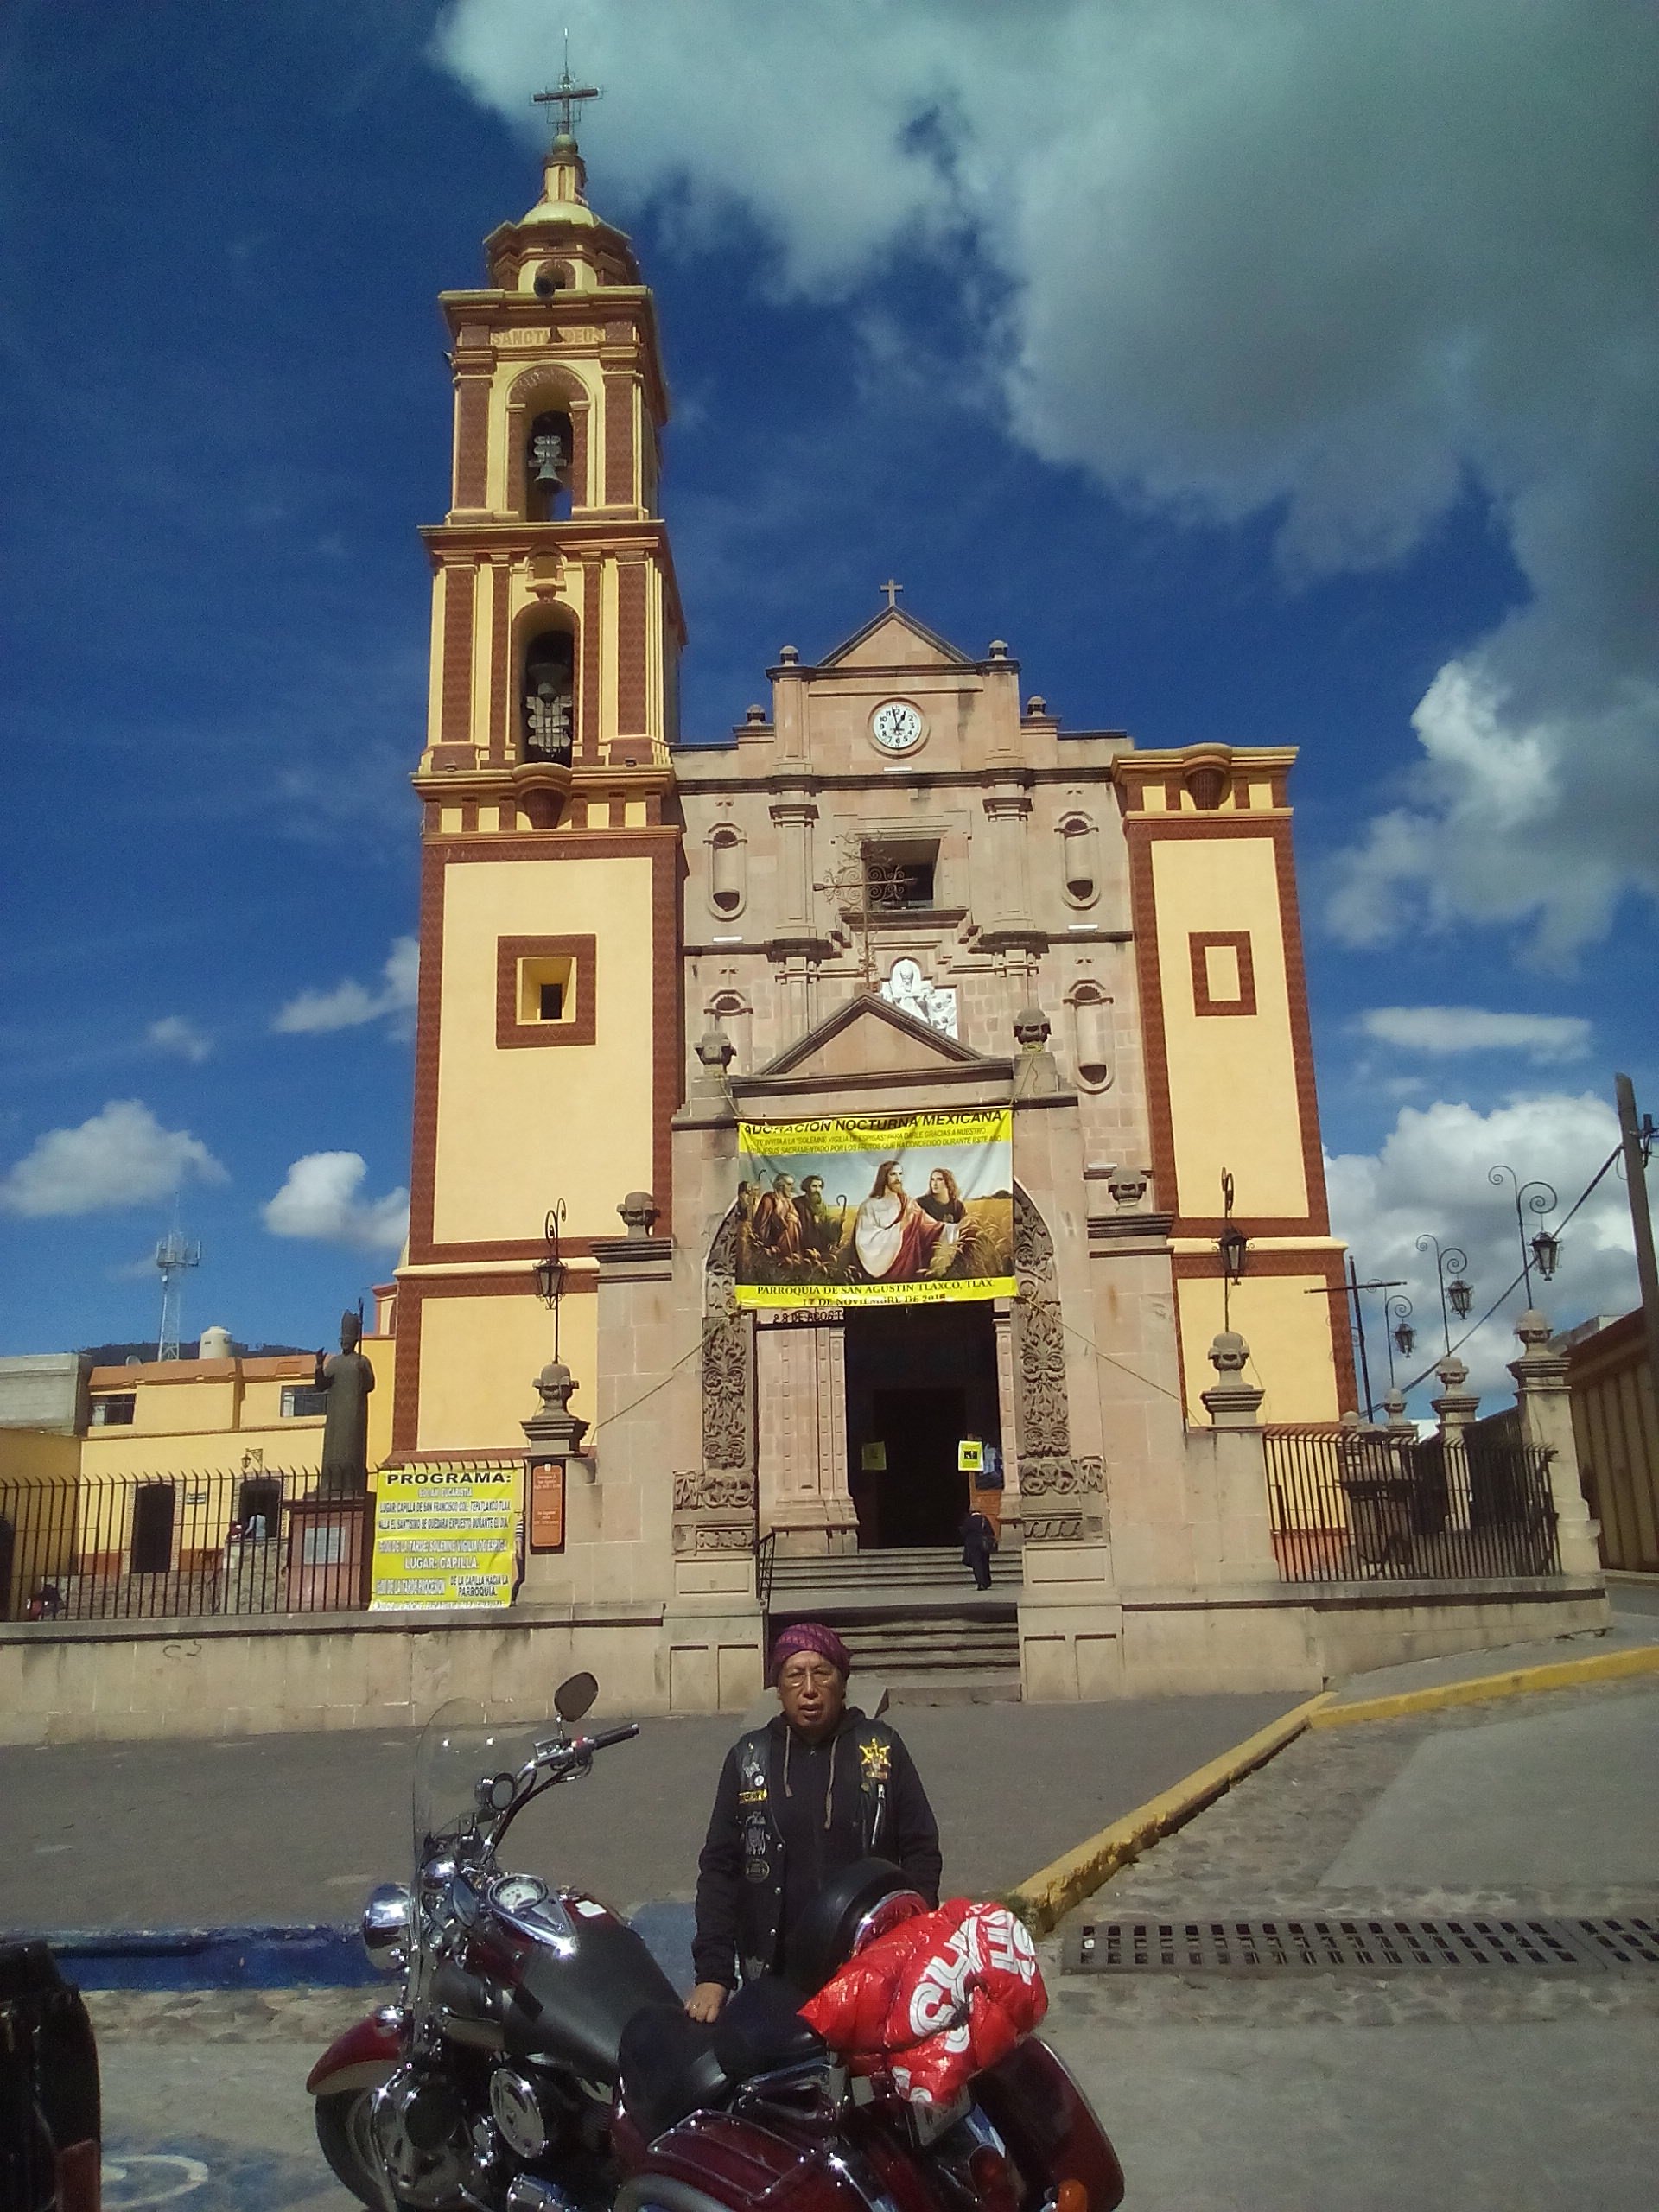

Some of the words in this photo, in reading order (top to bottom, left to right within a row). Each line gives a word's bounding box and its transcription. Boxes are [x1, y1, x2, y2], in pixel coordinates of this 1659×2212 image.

[492, 330, 555, 345] SANCT
[836, 1116, 918, 1130] NOCTURNA
[923, 1110, 1001, 1125] MEXICANA
[924, 1128, 951, 1137] GRACIAS
[943, 1136, 971, 1145] DURANTE
[973, 1135, 988, 1144] ESTE
[758, 1287, 821, 1295] PARROQUIA
[823, 1286, 838, 1294] DE
[842, 1285, 862, 1294] SAN
[865, 1284, 914, 1294] AGUSTIN
[918, 1281, 963, 1292] TLAXCO,
[905, 1294, 918, 1303] DE
[387, 1472, 512, 1484] PROGRAMA:
[404, 1556, 437, 1569] LUGAR:
